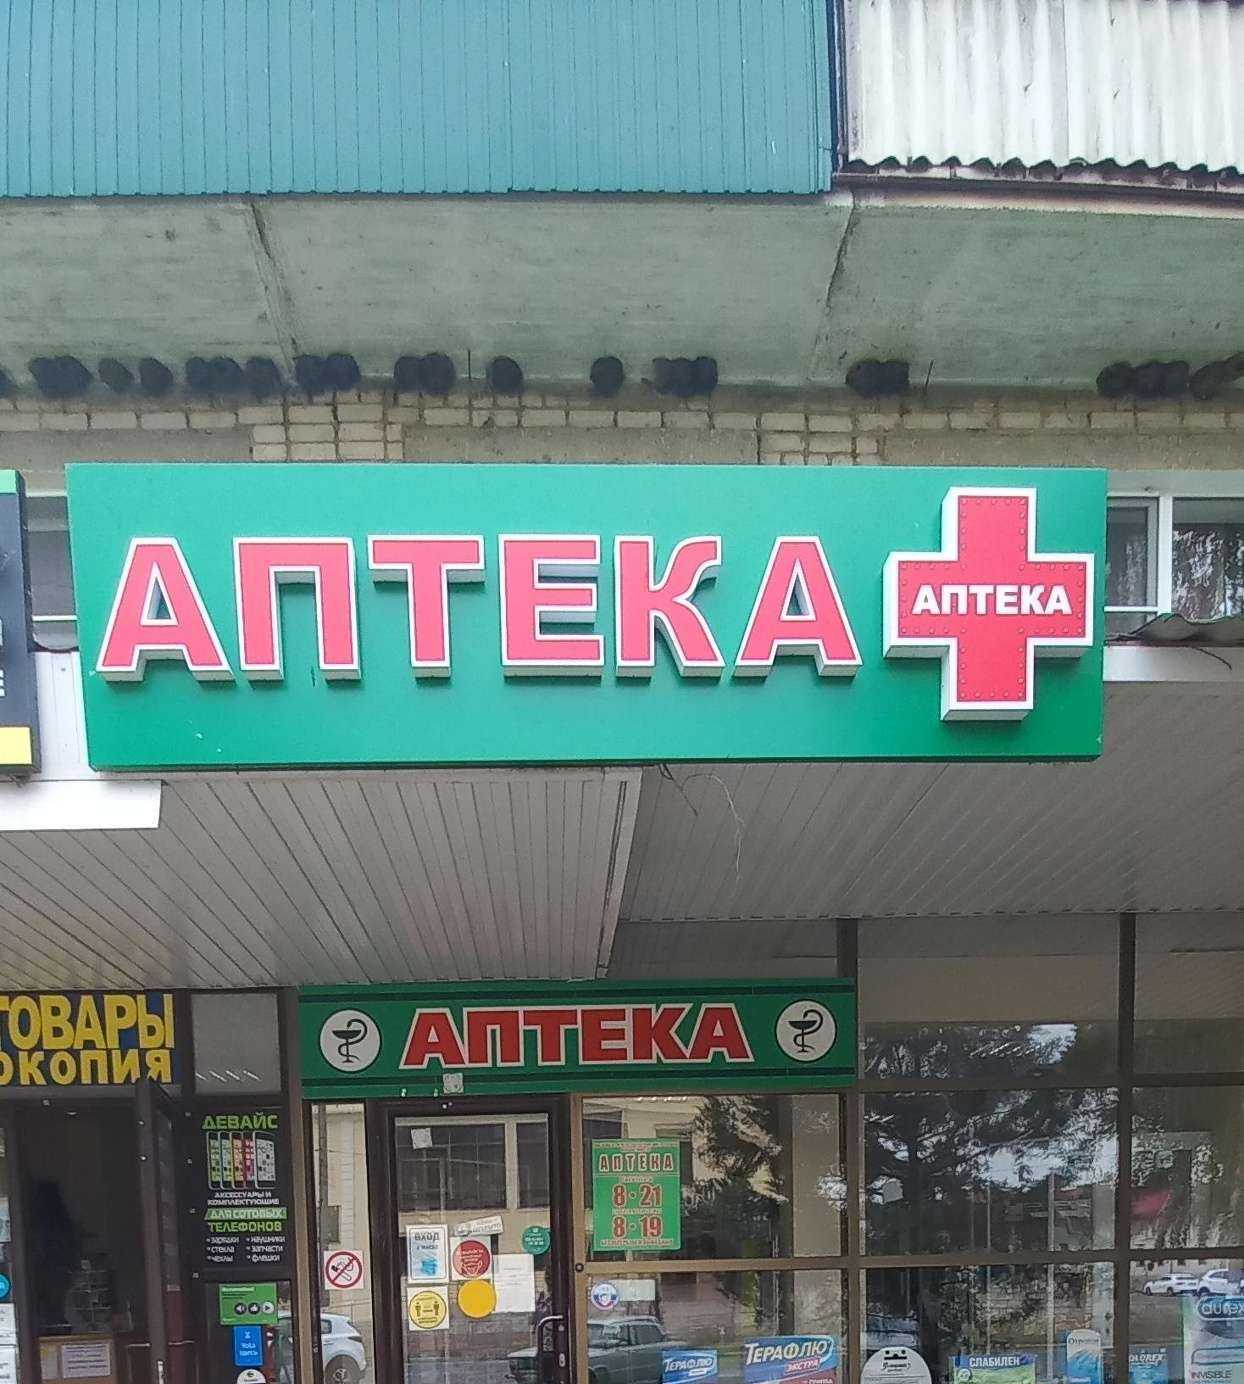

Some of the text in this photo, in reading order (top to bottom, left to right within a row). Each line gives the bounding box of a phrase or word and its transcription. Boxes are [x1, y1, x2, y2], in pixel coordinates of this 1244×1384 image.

[97, 535, 862, 680] АПТЕКА
[912, 584, 1073, 615] АПТЕКА
[0, 993, 175, 1050] ОВАРЫ
[399, 1003, 754, 1069] АПТЕКА
[202, 1112, 279, 1130] ДЕВАЙС
[598, 1153, 674, 1172] АПТЕКА
[207, 1221, 282, 1232] ТЕЛЕФОНОВ
[969, 1356, 1021, 1368] СЛАБИЛЕН
